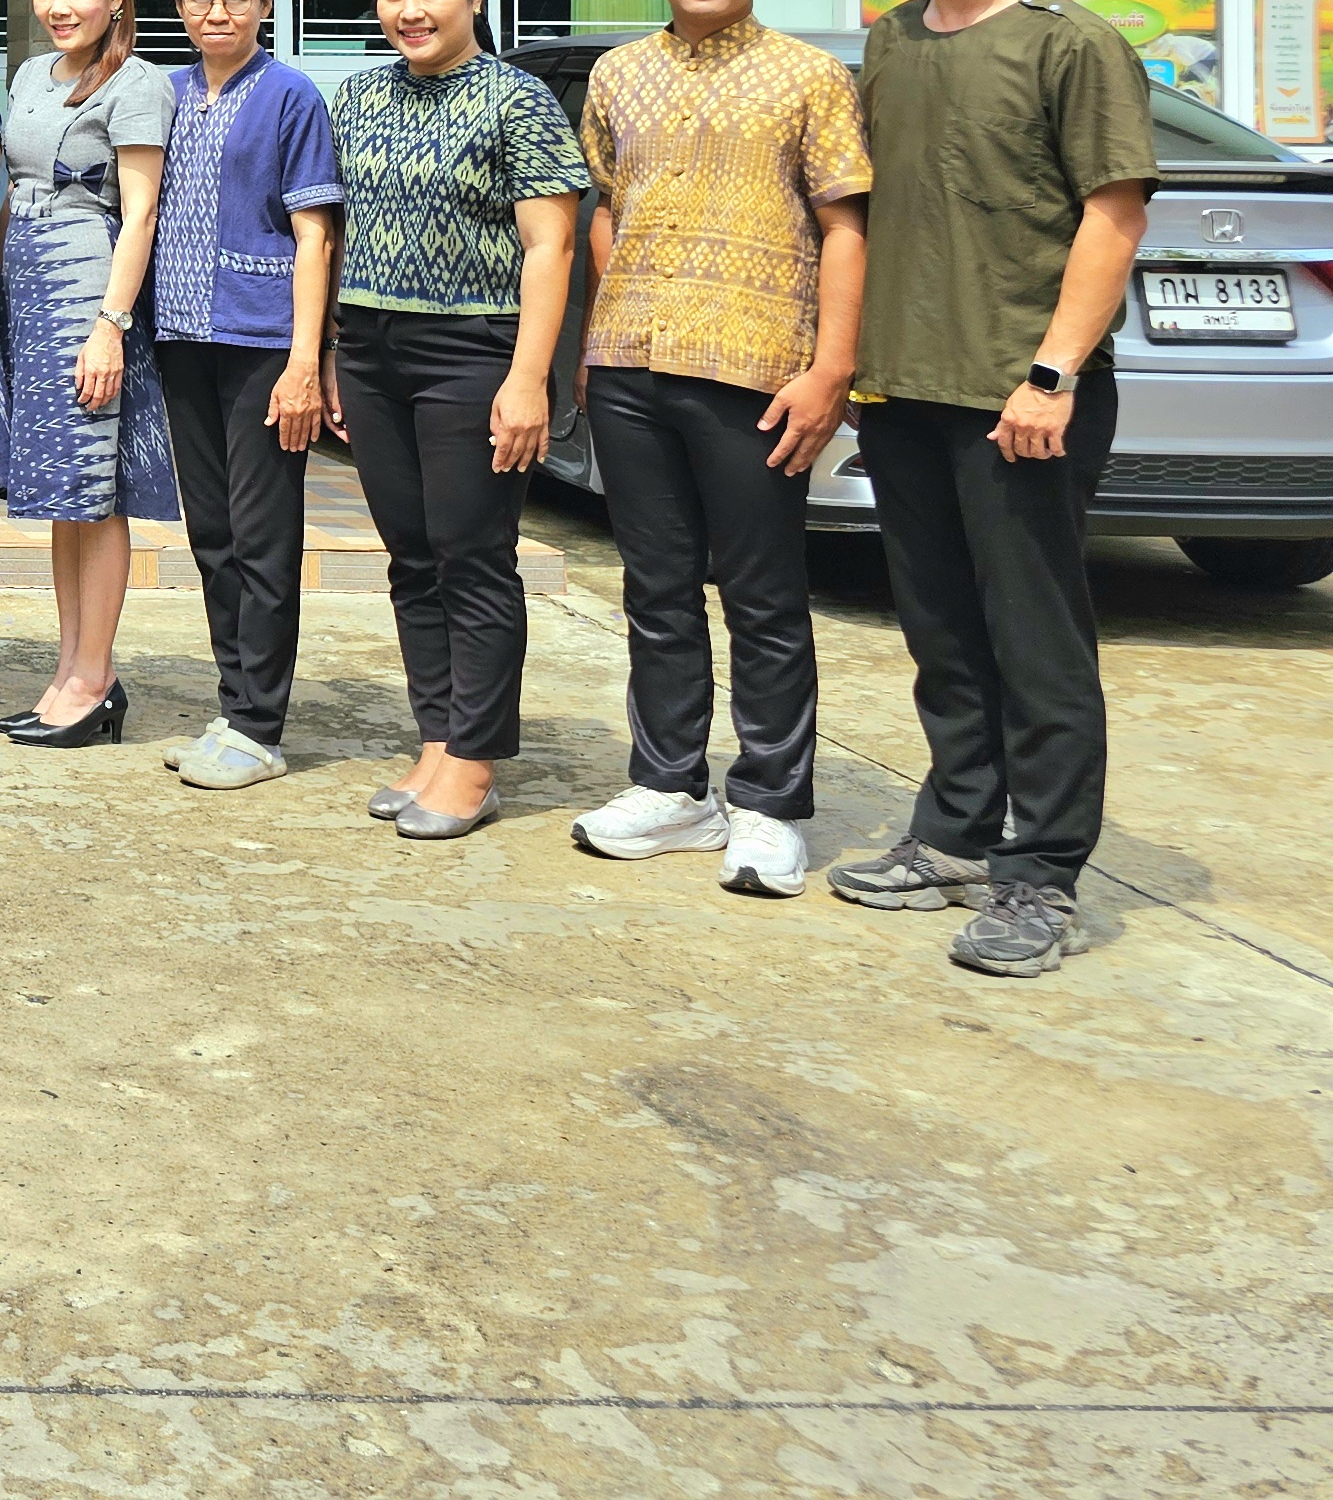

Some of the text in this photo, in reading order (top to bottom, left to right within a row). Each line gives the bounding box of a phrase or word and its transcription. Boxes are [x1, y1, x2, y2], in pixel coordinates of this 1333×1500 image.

[1215, 278, 1280, 304] 8133
[1202, 311, 1239, 329] ลพบุรี
